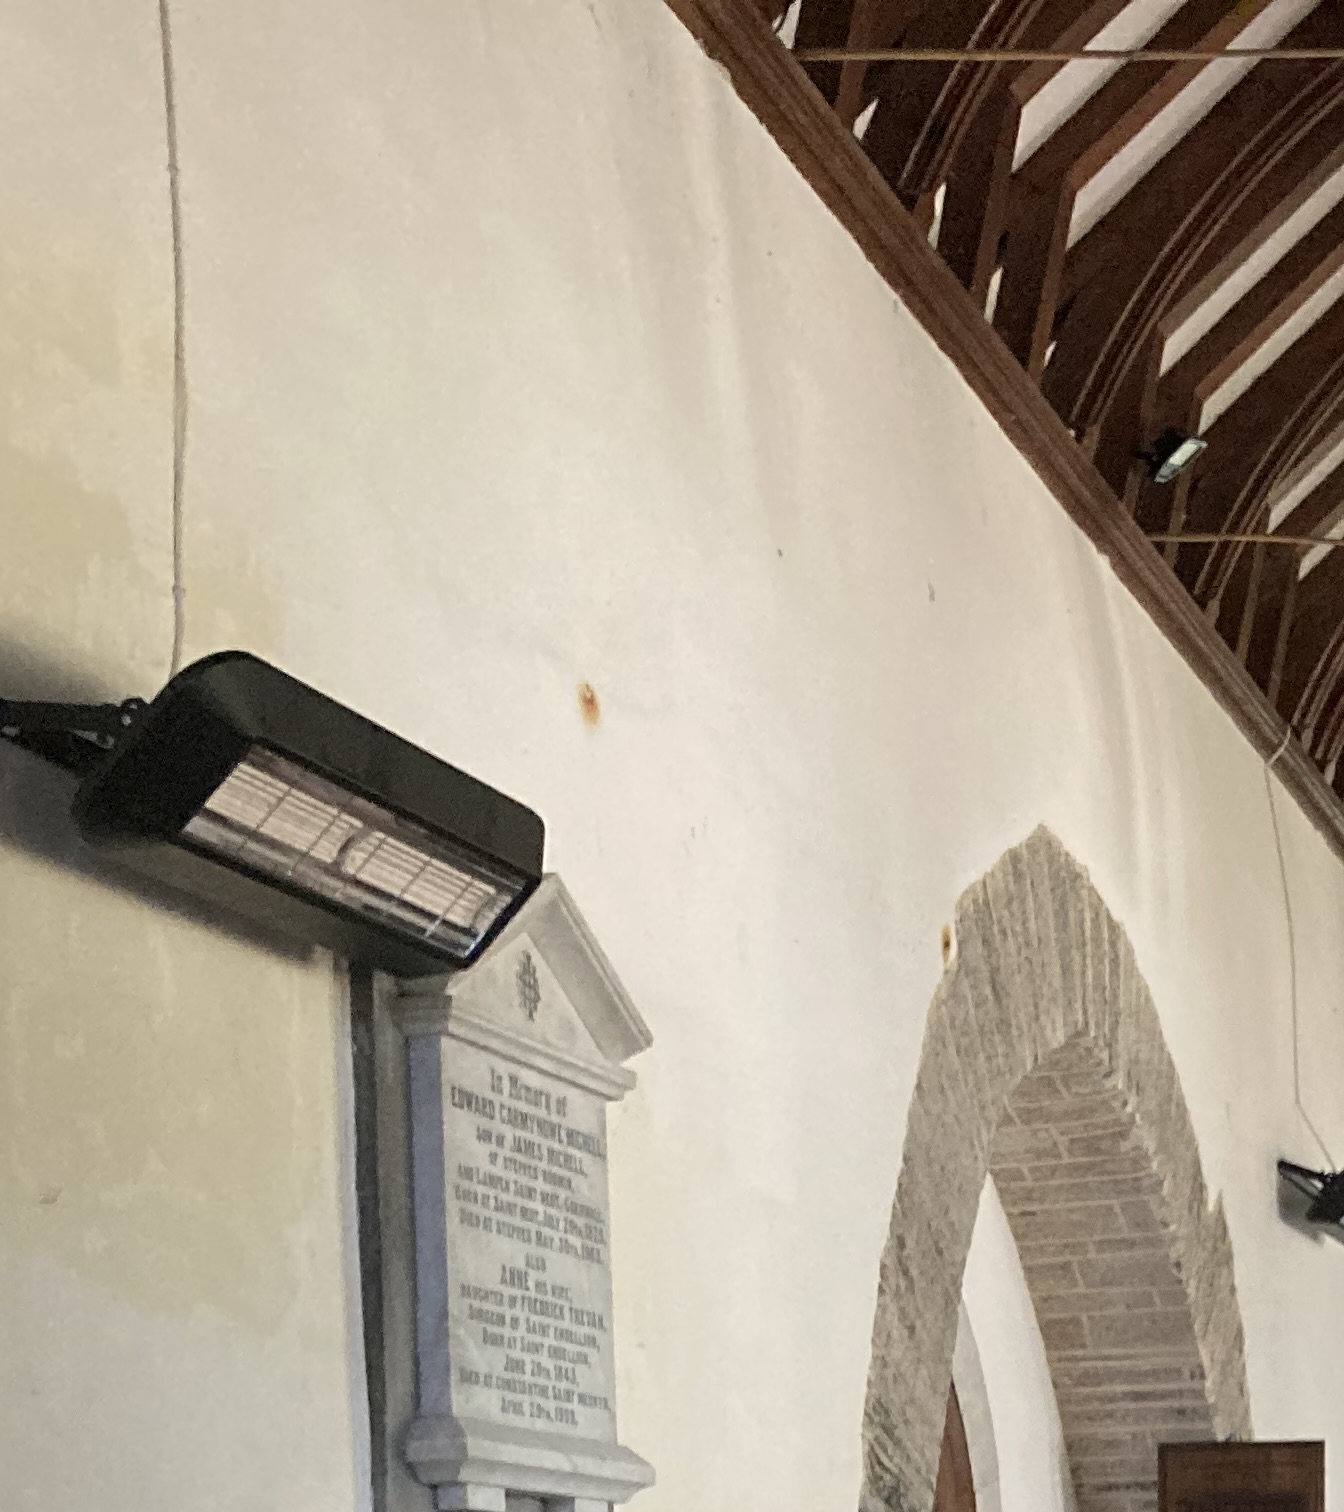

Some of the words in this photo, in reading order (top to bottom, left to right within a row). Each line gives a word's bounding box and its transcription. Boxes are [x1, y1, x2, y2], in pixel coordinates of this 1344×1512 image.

[451, 1085, 495, 1120] EDWARD
[508, 1074, 551, 1114] Memory
[510, 1134, 542, 1161] JAMES
[500, 1264, 529, 1291] ANNE
[526, 1317, 550, 1338] SAINT
[520, 1336, 545, 1356] SAINT
